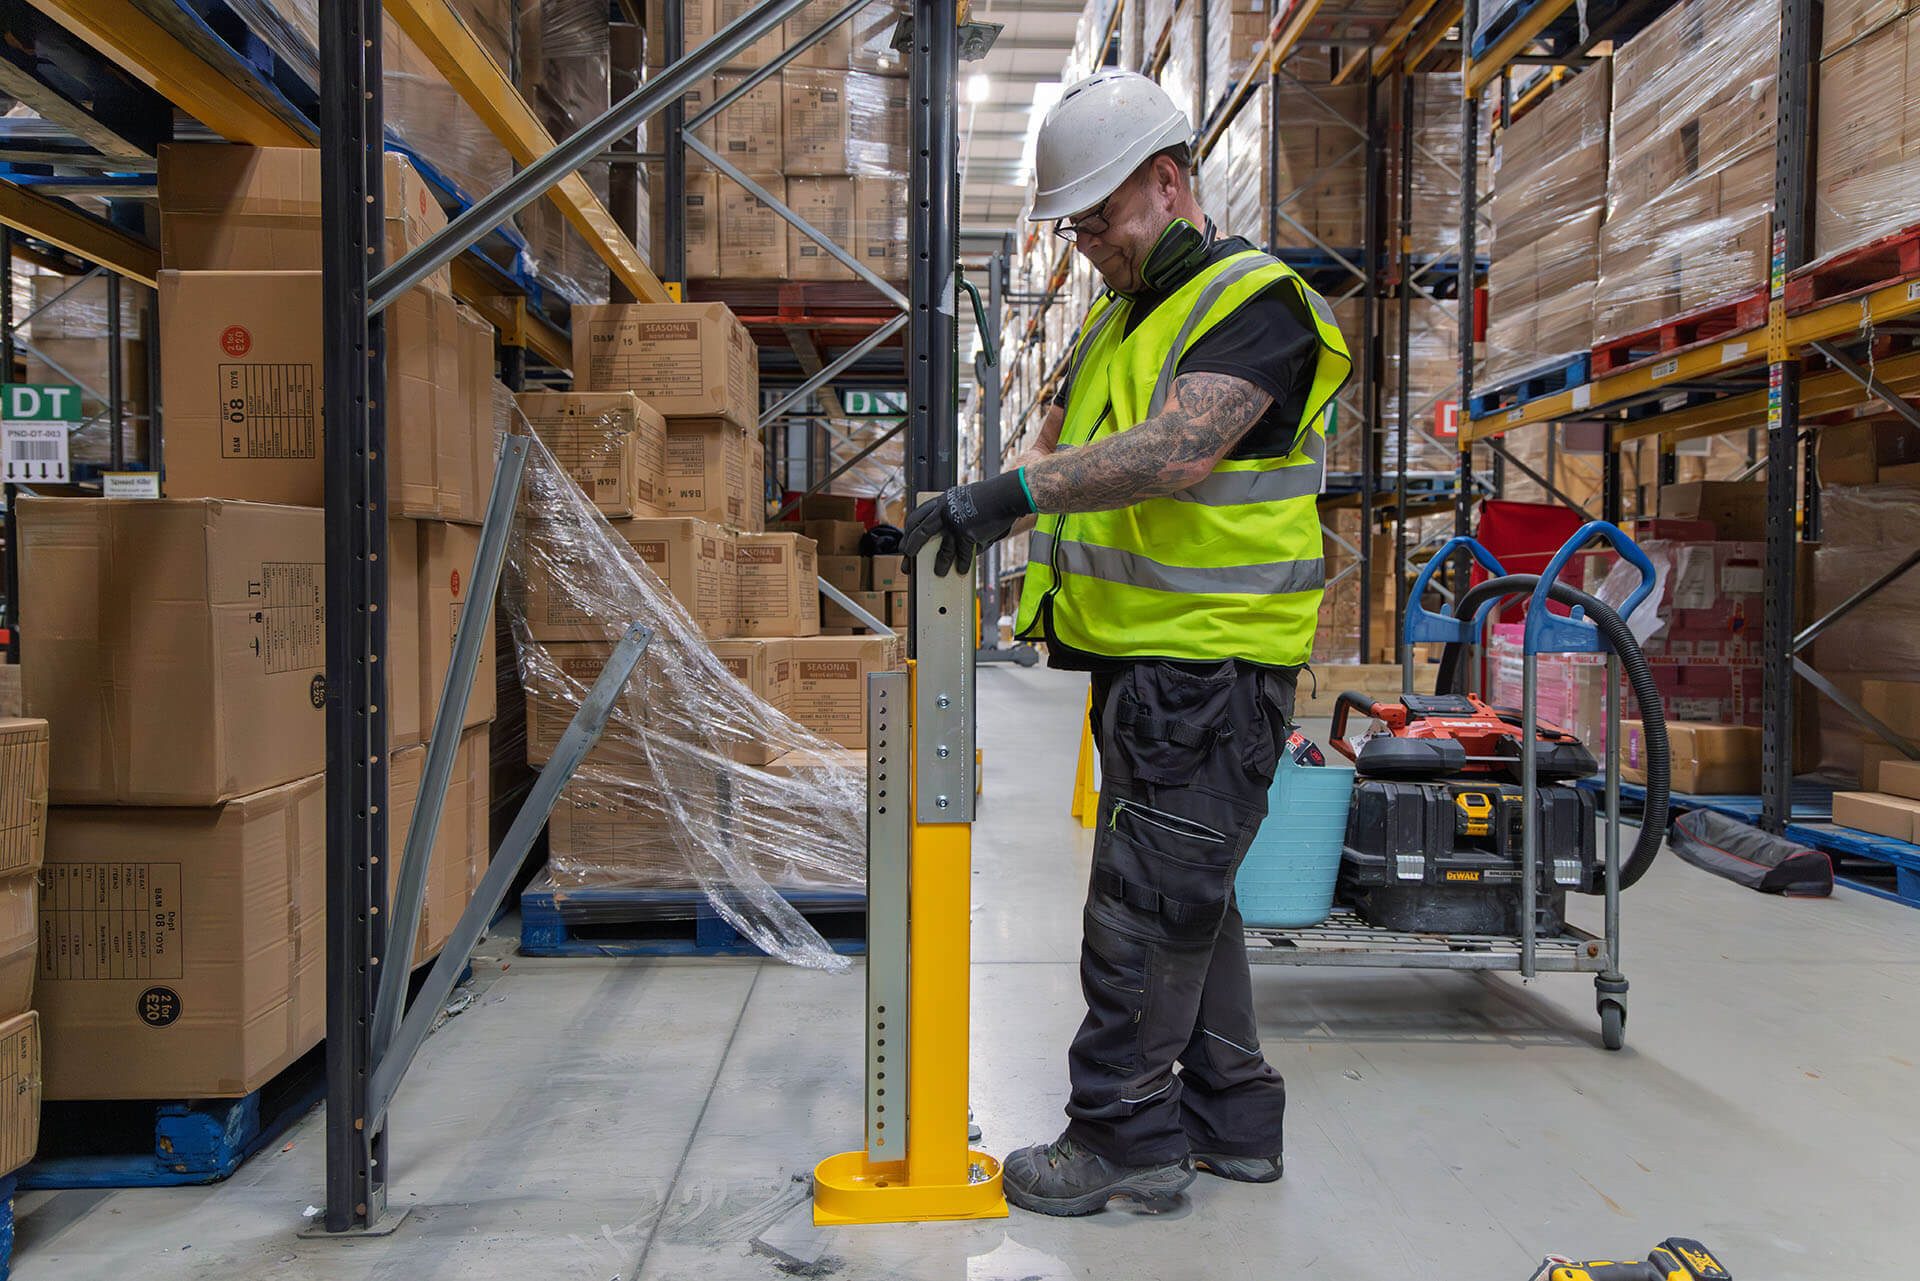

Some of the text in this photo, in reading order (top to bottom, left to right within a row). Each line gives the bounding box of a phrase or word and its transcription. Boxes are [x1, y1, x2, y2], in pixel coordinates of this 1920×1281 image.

[646, 324, 691, 332] SEASONAL
[593, 334, 633, 346] B&M 15
[12, 387, 71, 418] DT
[230, 370, 245, 453] B&M 08 TOYS
[597, 477, 616, 486] B&M
[680, 489, 701, 498] B&M
[807, 663, 850, 671] SEASONAL
[154, 888, 165, 955] B&M 08 TOYS
[166, 911, 176, 931] Dept
[146, 994, 160, 1020] £20
[161, 1004, 173, 1019] for
